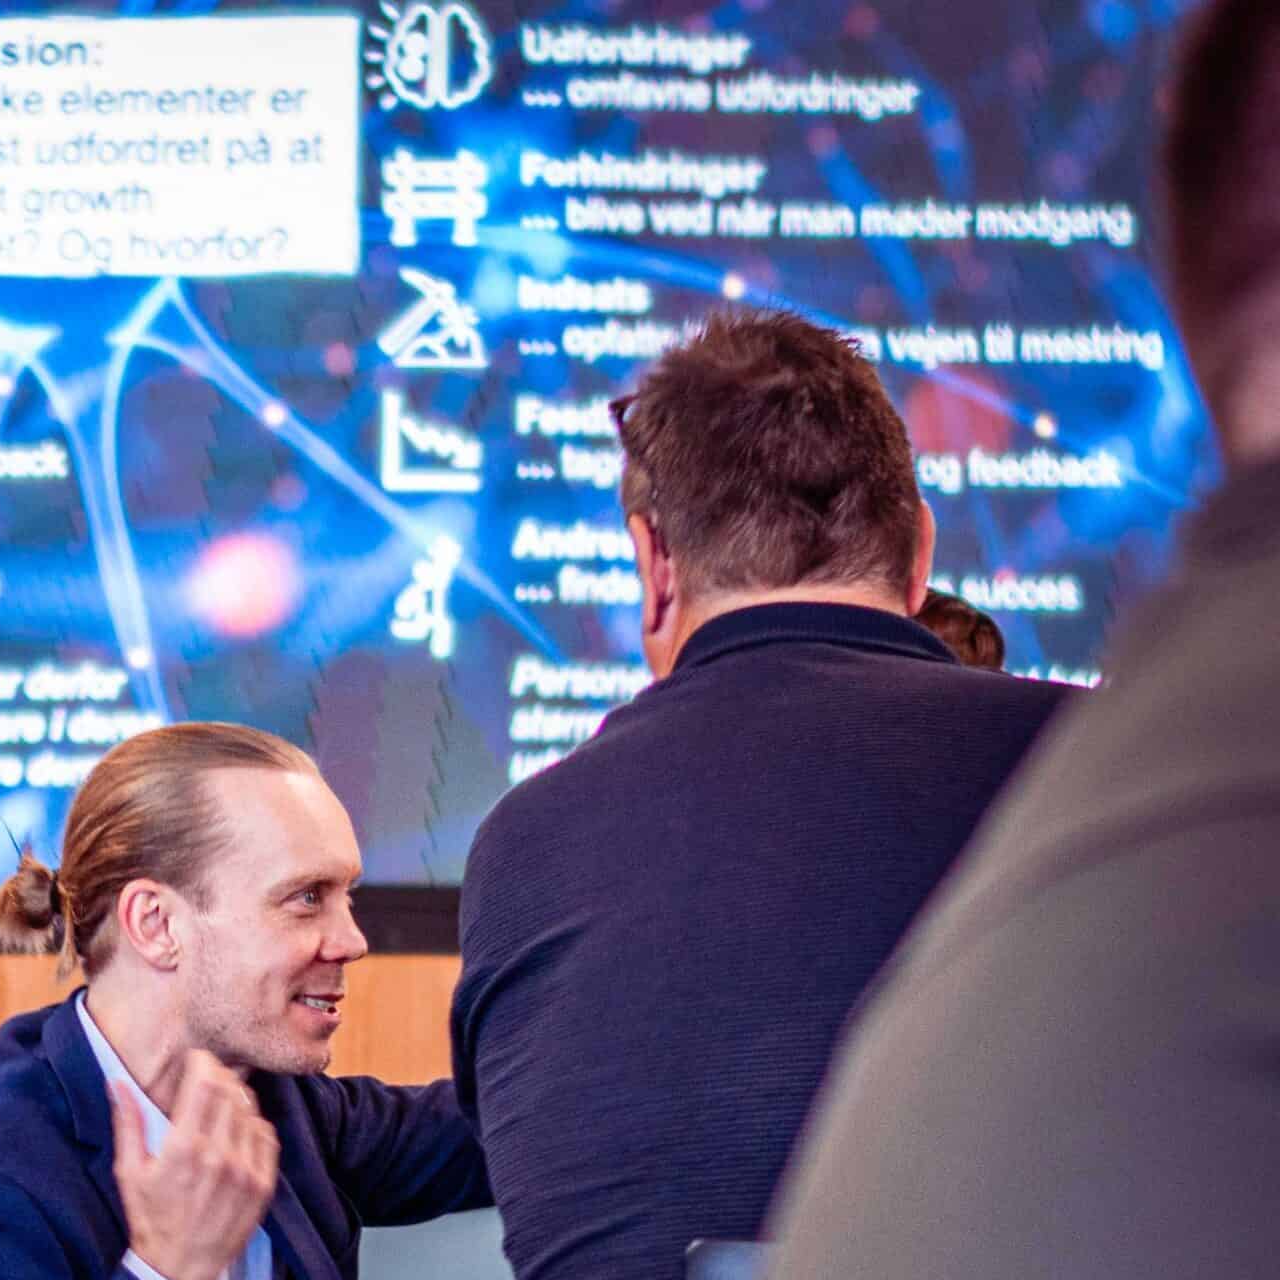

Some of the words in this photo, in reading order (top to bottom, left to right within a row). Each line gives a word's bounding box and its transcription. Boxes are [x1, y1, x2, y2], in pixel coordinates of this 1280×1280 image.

[523, 28, 750, 73] Udfordringer
[60, 84, 254, 116] elementer
[271, 87, 307, 115] er
[567, 75, 711, 113] omfavne
[718, 75, 919, 120] udfordringer
[37, 132, 209, 166] udfordret
[226, 133, 271, 170] på
[289, 135, 325, 164] at
[521, 155, 765, 195] Forhindringer
[23, 184, 153, 220] growth
[565, 202, 646, 234] blive
[651, 203, 713, 235] ved
[718, 200, 775, 235] når
[782, 210, 855, 237] man
[977, 205, 1135, 245] modgang
[57, 231, 112, 268] Og
[128, 228, 289, 263] hvorfor?
[518, 275, 650, 312] Indsats
[887, 327, 978, 370] vejen
[984, 323, 1014, 362] til
[1020, 325, 1164, 370] mestring
[916, 455, 961, 494] og
[968, 448, 1121, 487] feedback
[961, 575, 1083, 611] succes
